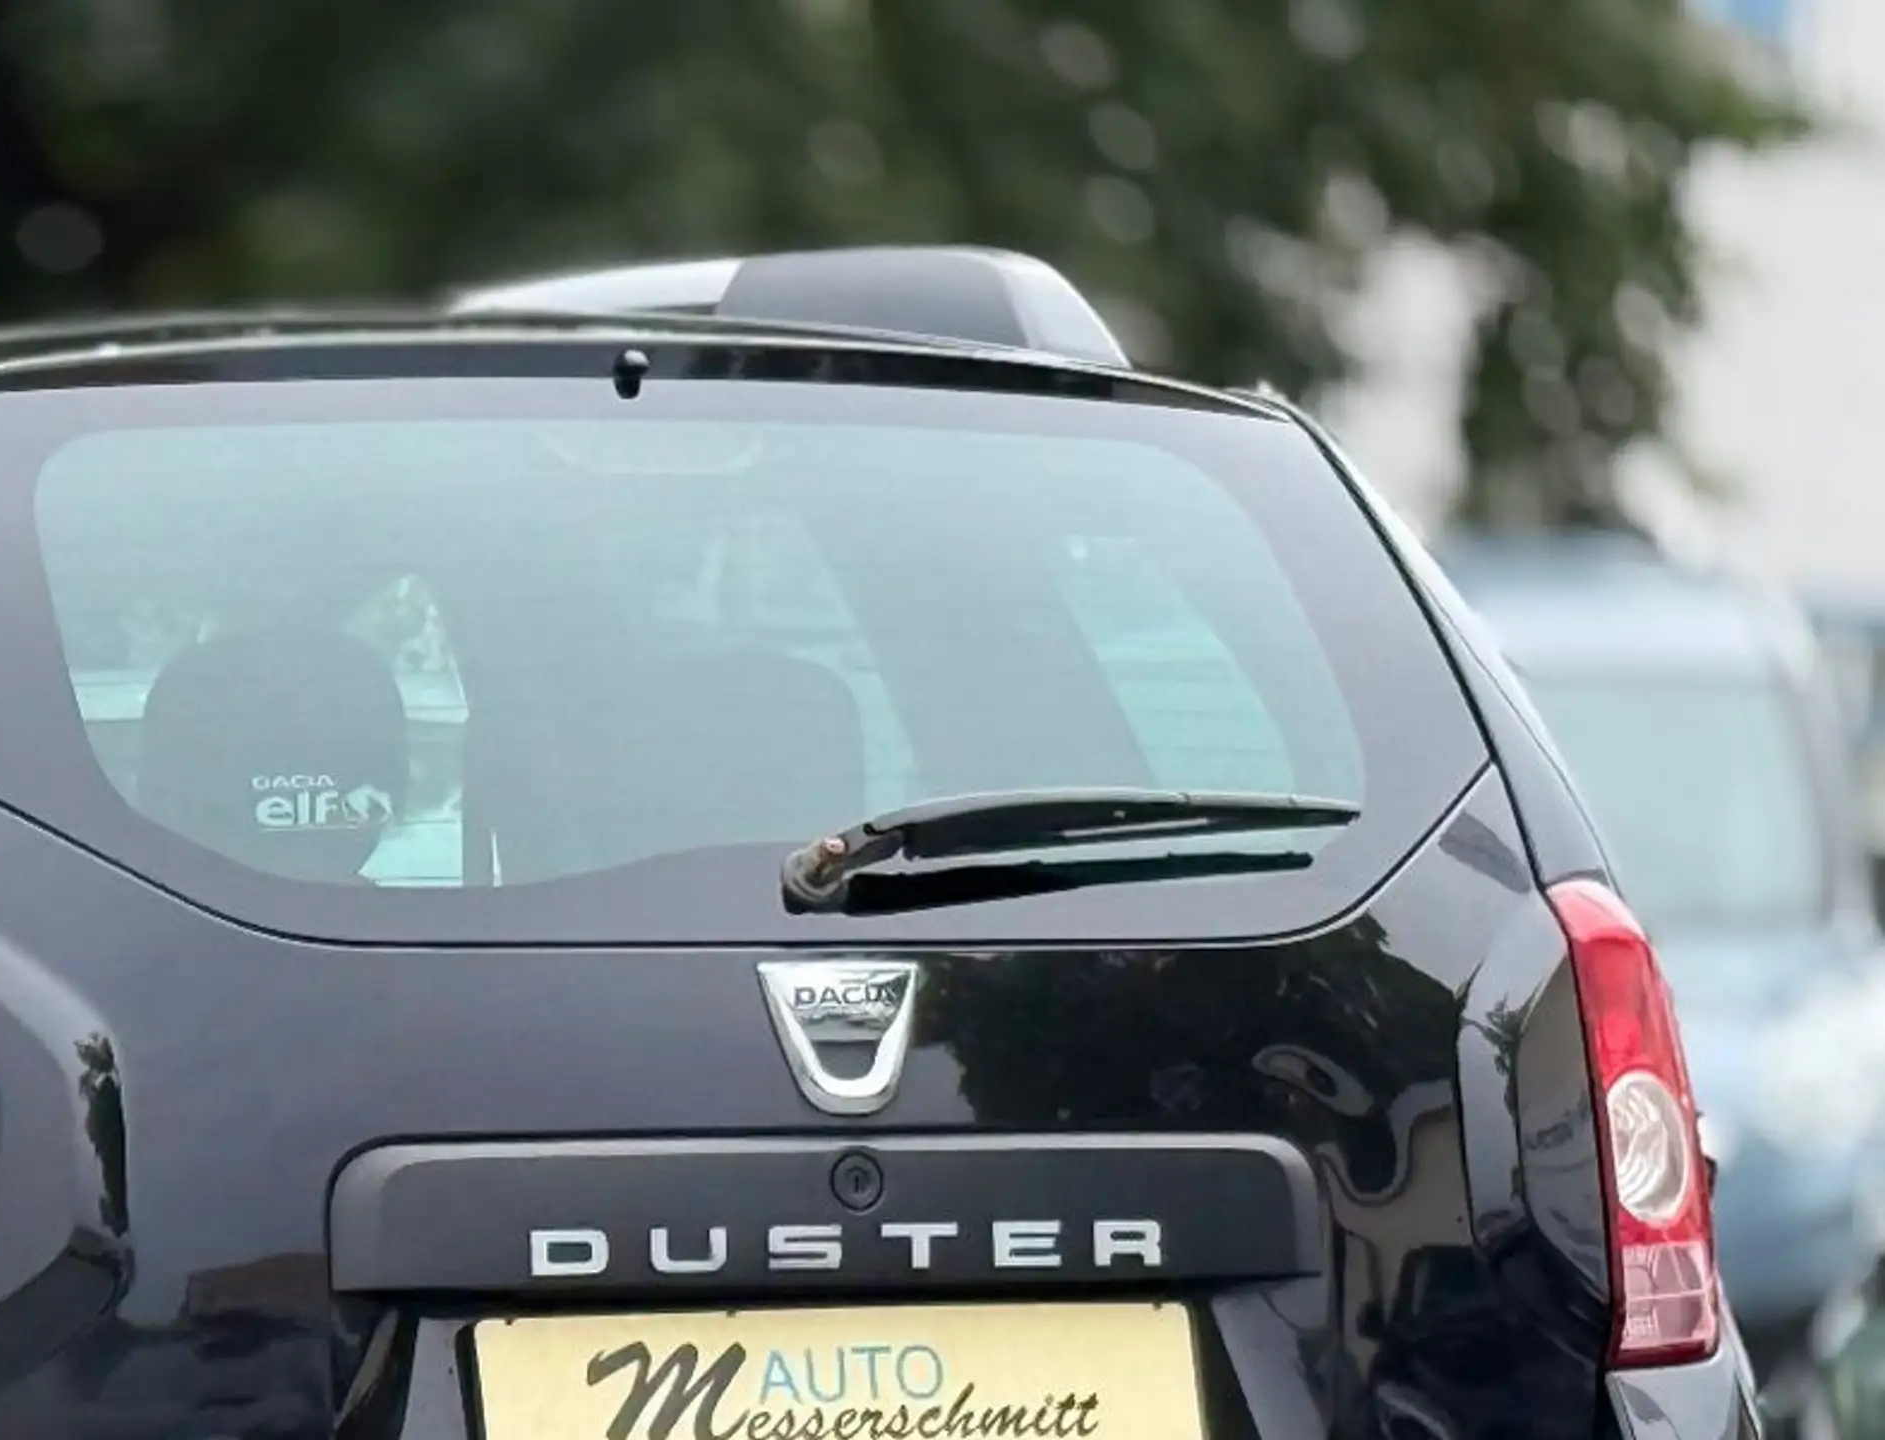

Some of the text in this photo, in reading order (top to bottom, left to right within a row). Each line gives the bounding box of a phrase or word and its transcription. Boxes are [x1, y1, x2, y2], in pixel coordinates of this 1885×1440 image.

[255, 789, 339, 826] elf
[794, 985, 898, 1006] DACIA
[529, 1218, 1164, 1277] DUSTER
[758, 1344, 945, 1406] AUTO
